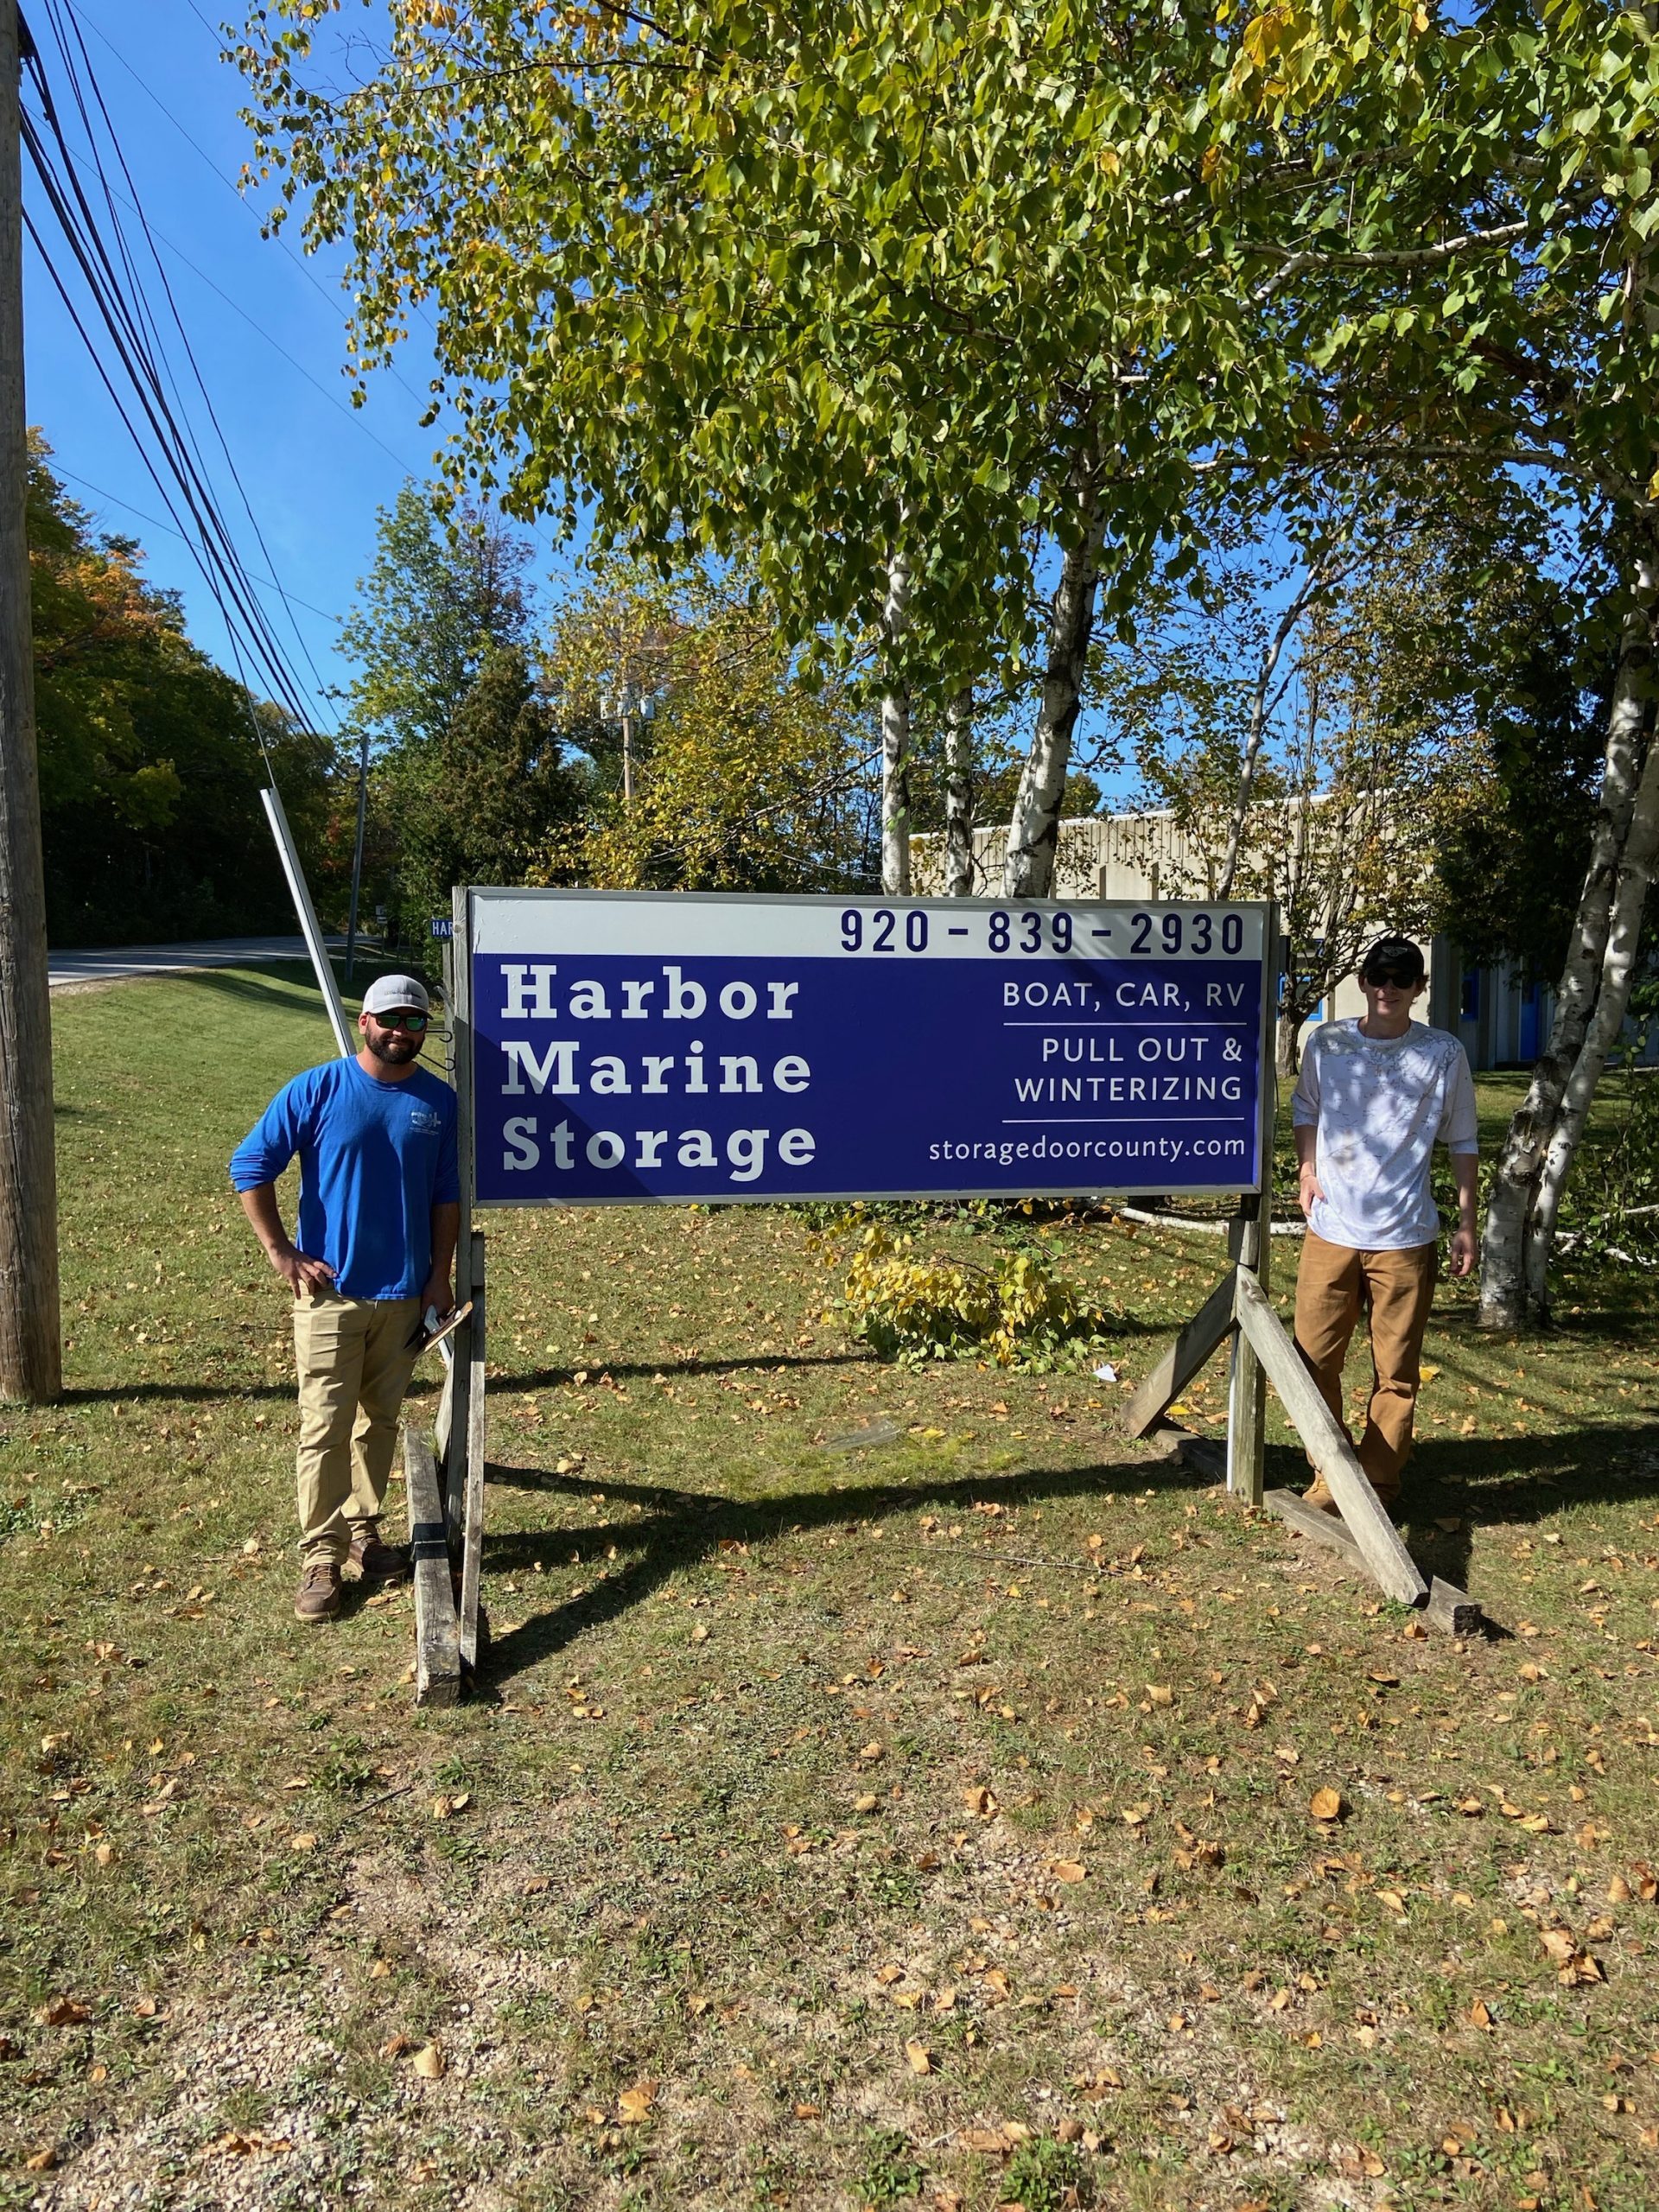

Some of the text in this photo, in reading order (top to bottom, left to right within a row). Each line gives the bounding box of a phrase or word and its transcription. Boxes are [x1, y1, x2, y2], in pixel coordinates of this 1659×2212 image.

[500, 963, 799, 1020] Harbor
[1003, 982, 1245, 1012] BOAT, CAR, RV
[1042, 1037, 1243, 1063] PULL OUT &
[500, 1039, 811, 1095] Marine
[1014, 1076, 1243, 1103] WINTERIZING
[502, 1116, 816, 1182] Storage
[929, 1135, 1245, 1166] storagedoorcounty.com
